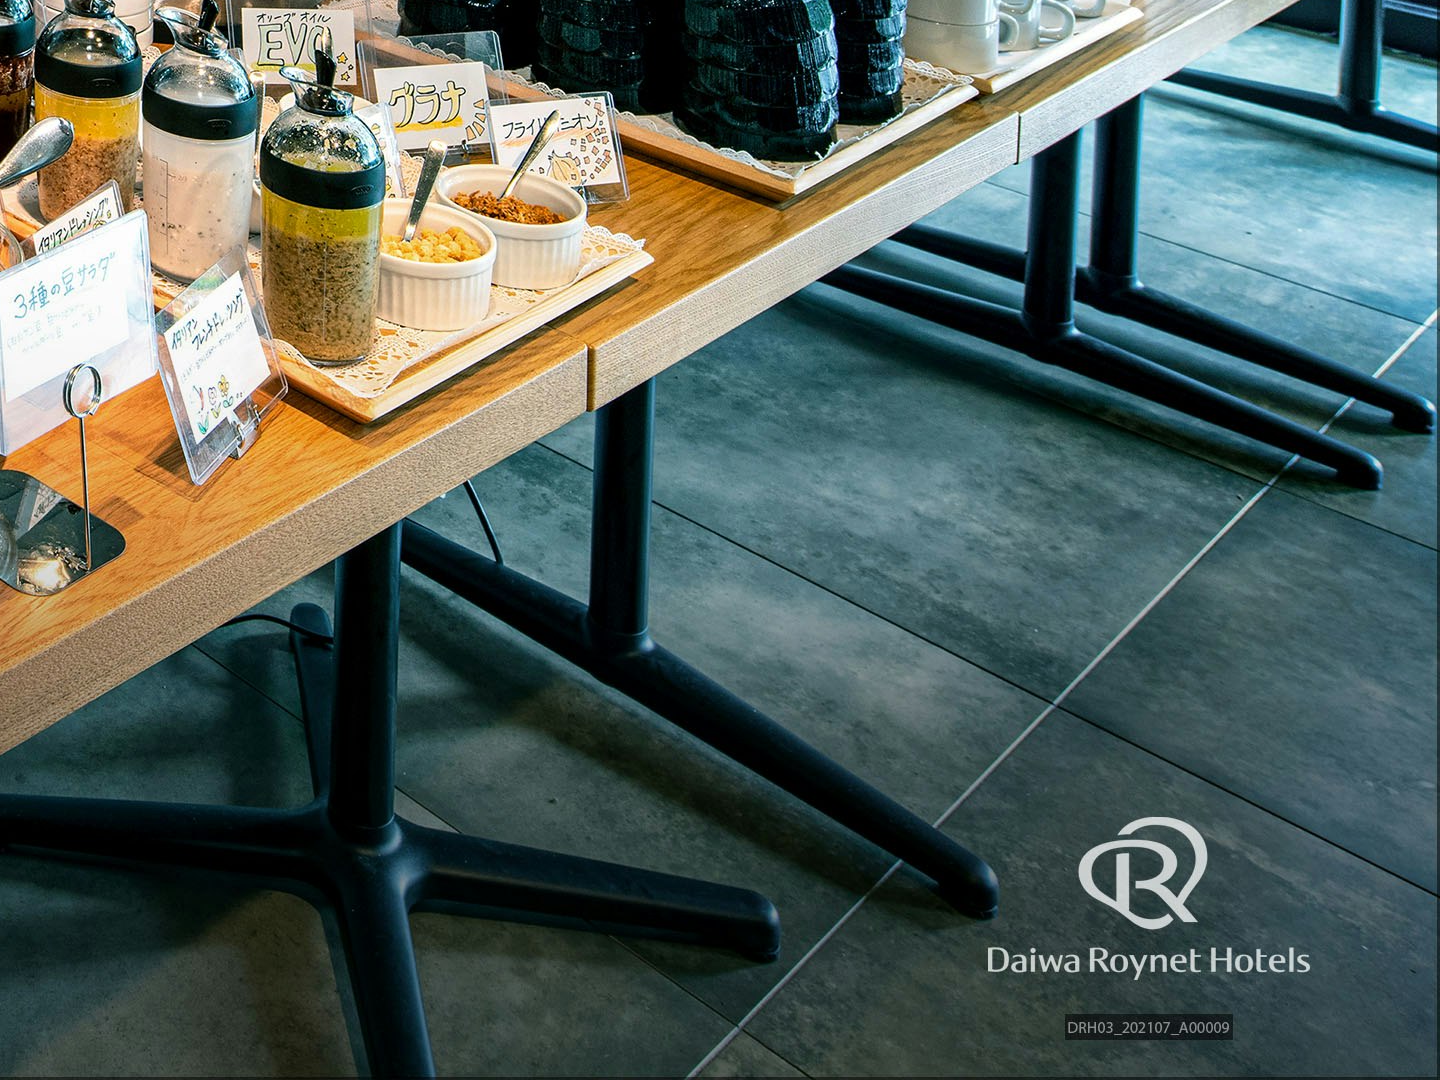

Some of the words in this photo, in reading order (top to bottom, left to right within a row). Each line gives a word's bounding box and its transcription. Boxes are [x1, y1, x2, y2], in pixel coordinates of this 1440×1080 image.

[389, 80, 466, 128] グラナ
[14, 252, 116, 319] 3種の豆サラダ
